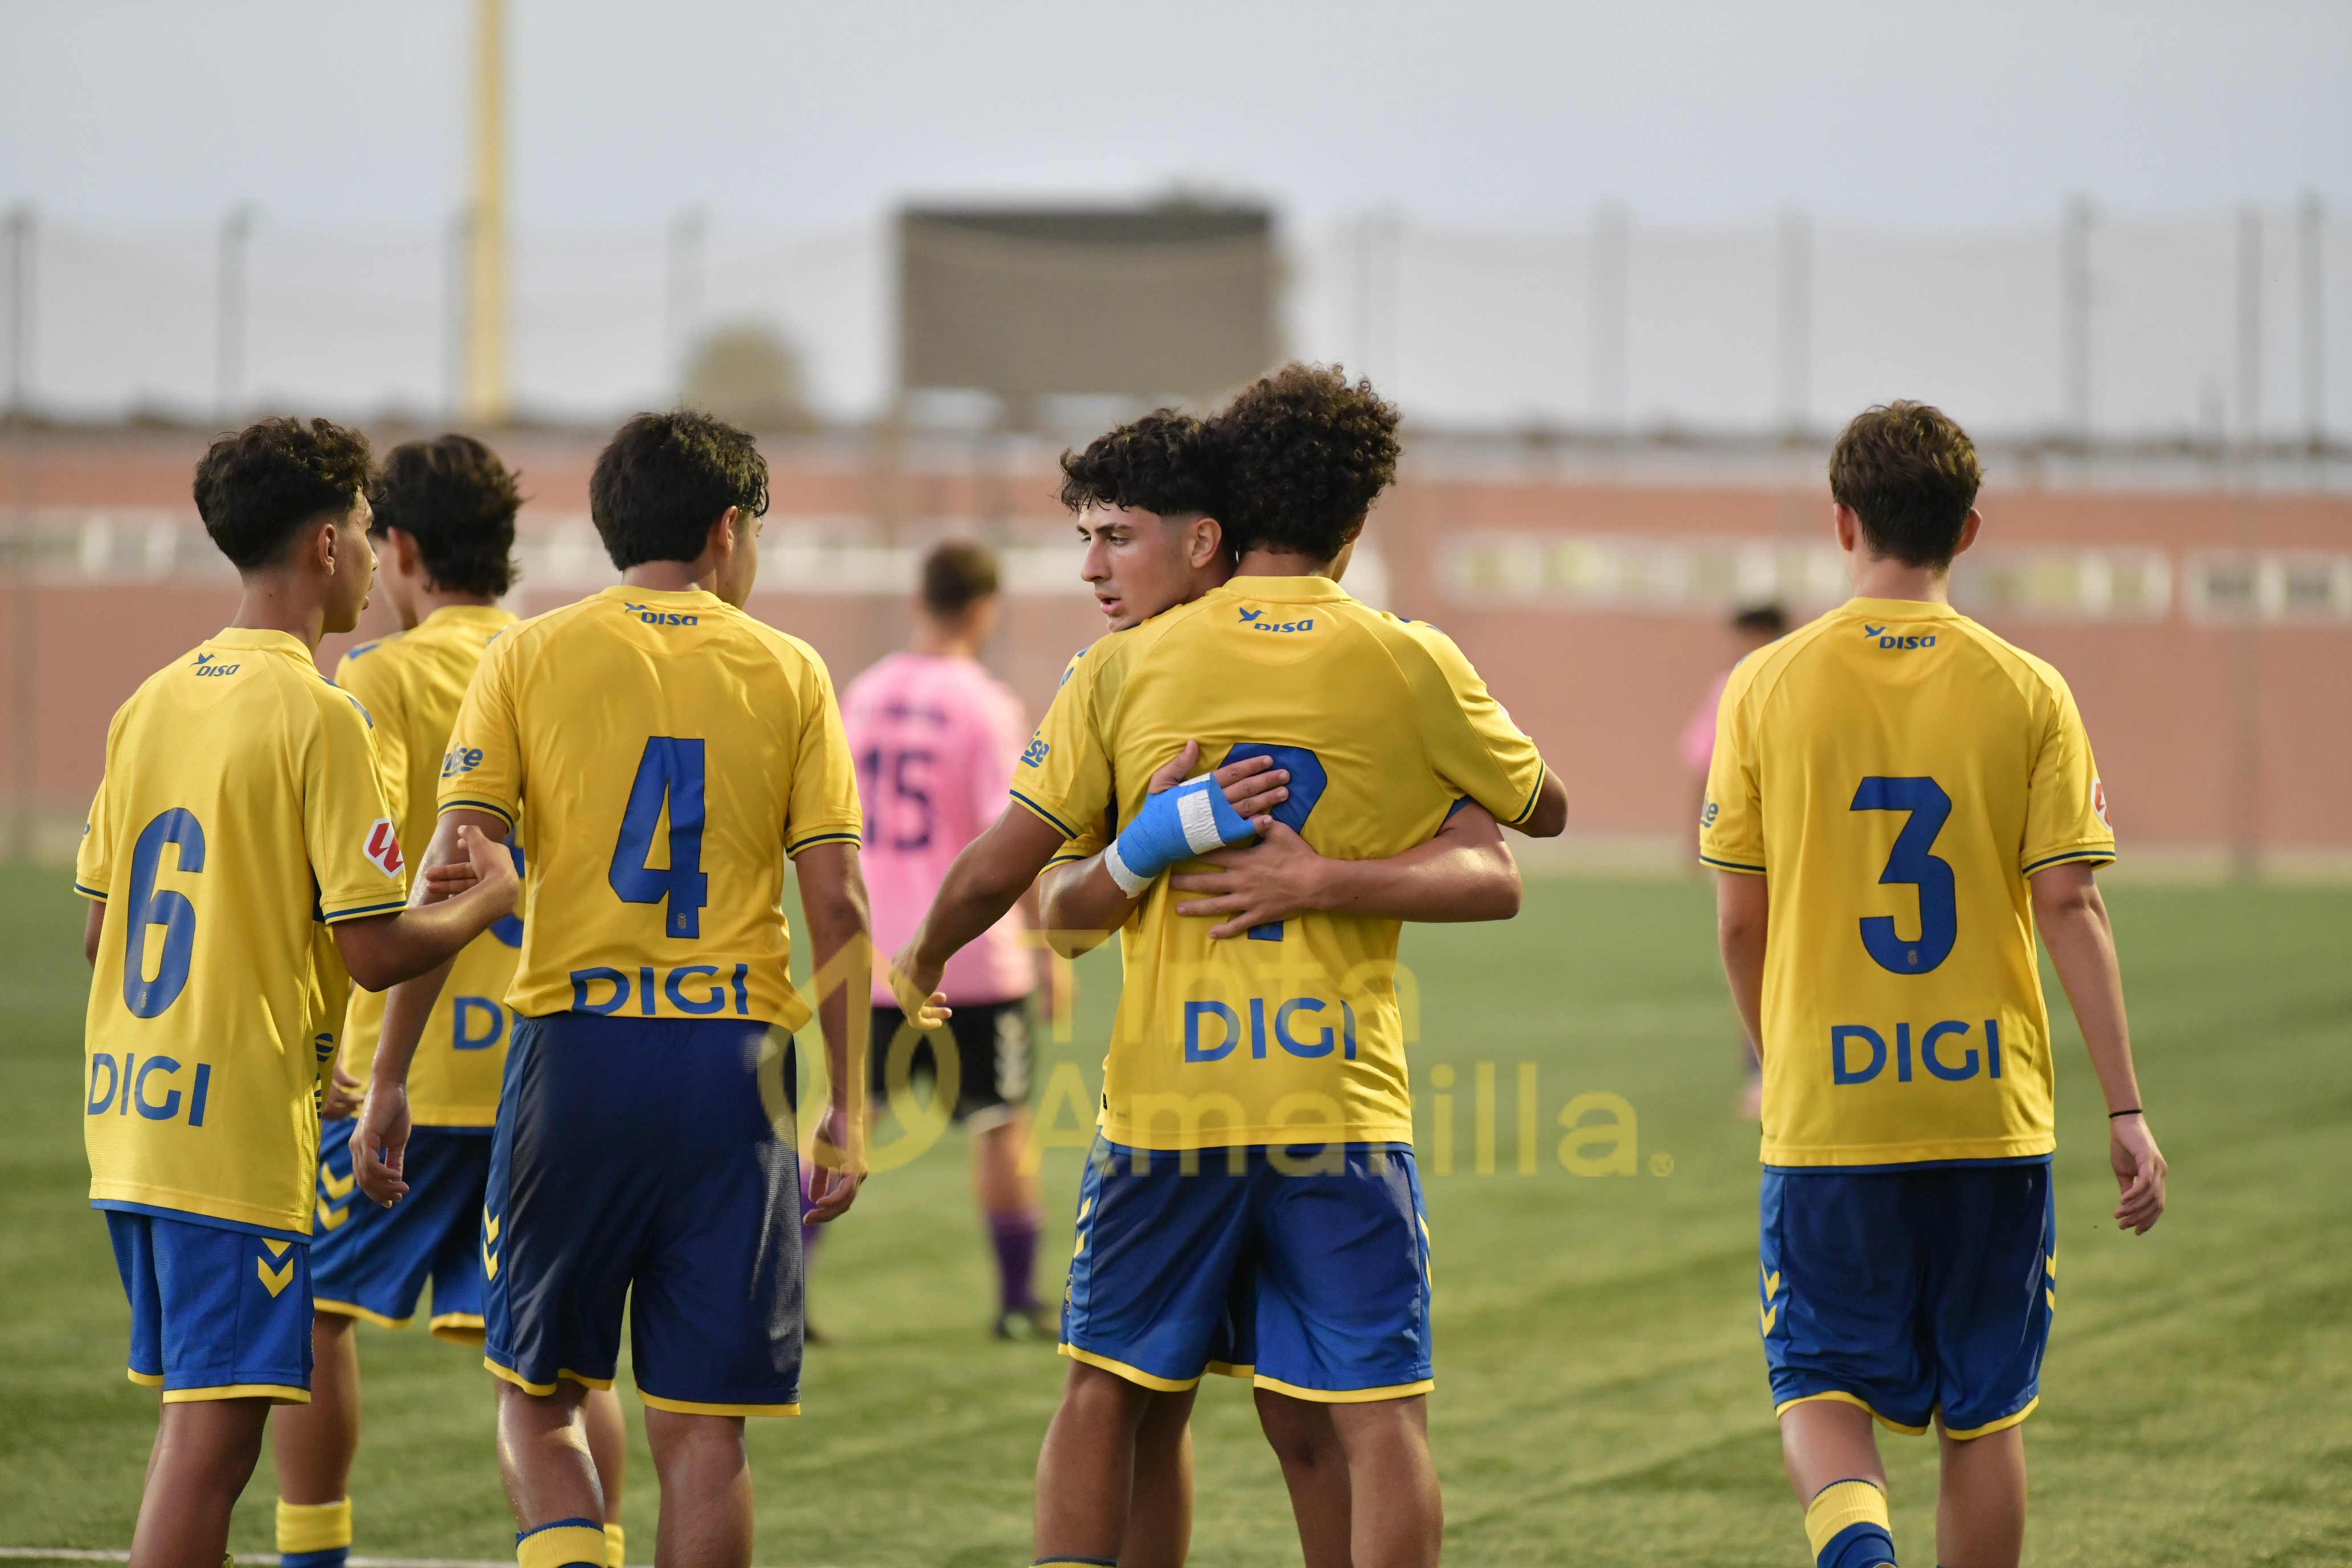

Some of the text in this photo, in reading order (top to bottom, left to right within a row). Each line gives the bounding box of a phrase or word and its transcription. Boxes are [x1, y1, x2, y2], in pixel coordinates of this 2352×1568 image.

[609, 736, 707, 939] 4
[861, 746, 934, 851] 15
[122, 807, 206, 1019] 6
[1849, 775, 1957, 975] 3
[570, 963, 749, 1016] DIGI
[1185, 997, 1357, 1064] DIGI
[87, 1052, 211, 1128] DIGI
[1831, 1019, 2001, 1085] DIGI
